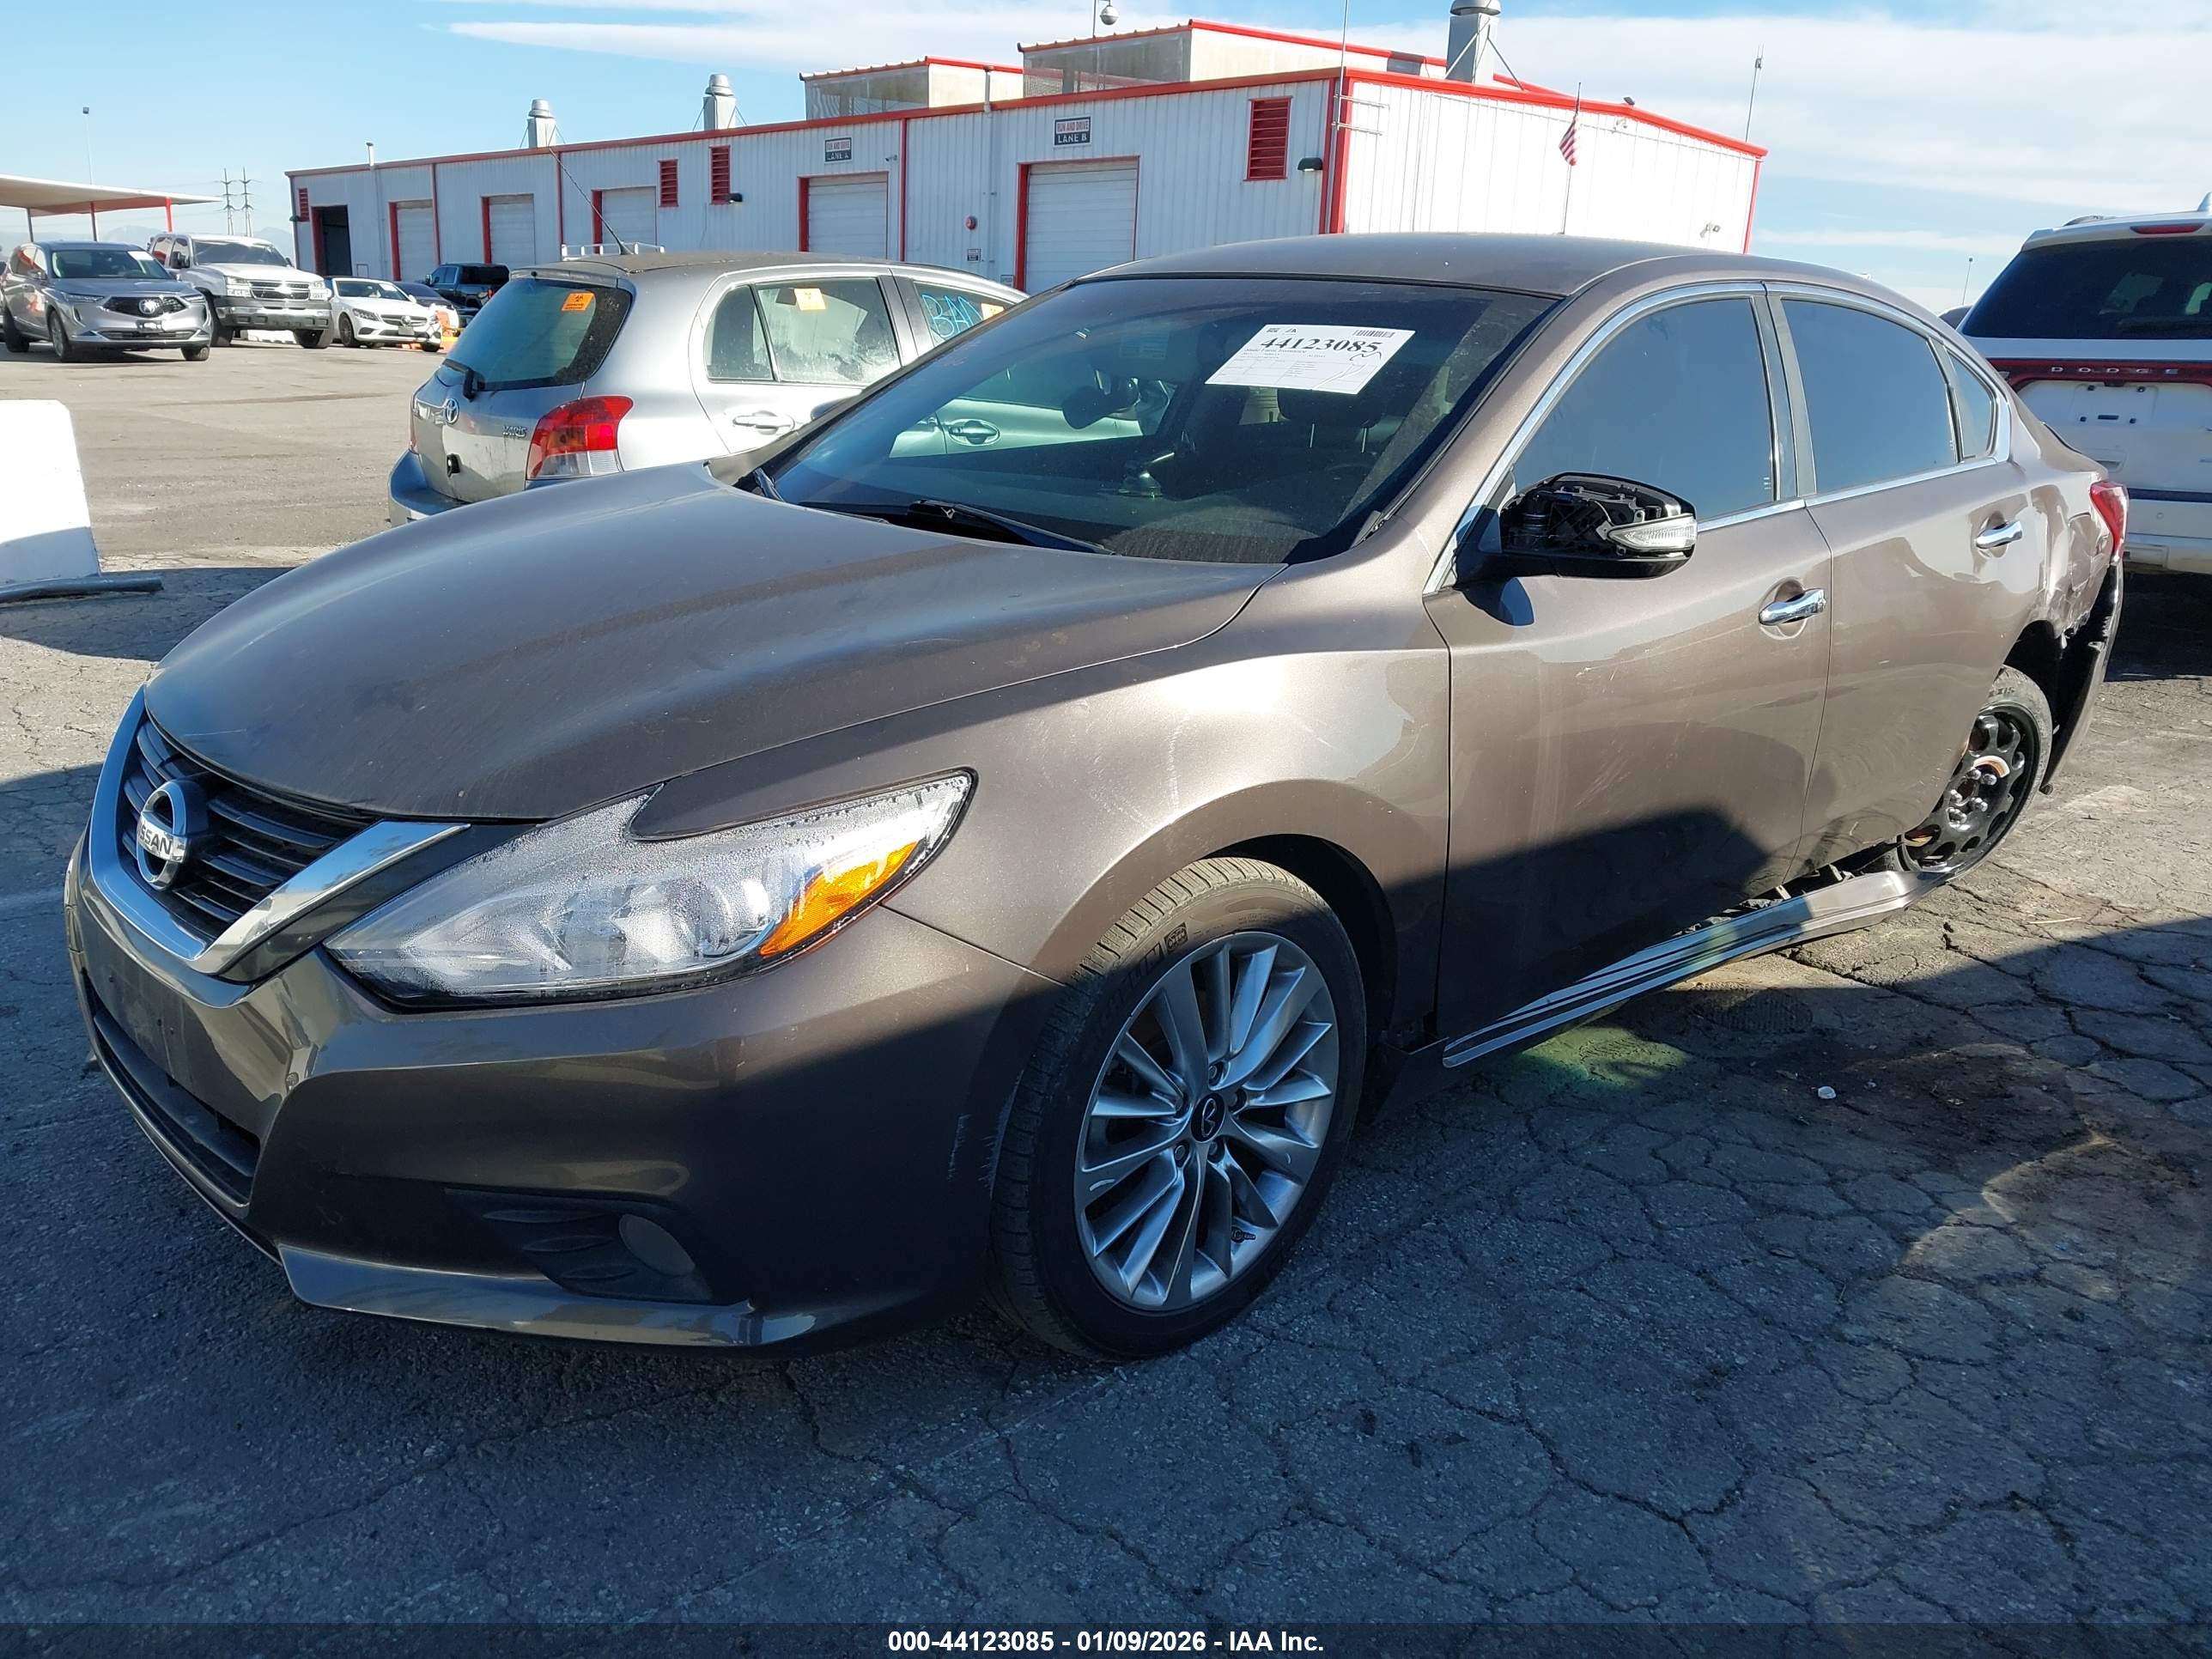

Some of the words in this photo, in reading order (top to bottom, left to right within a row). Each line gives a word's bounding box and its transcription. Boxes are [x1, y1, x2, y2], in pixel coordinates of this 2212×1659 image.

[1058, 133, 1079, 143] LANE
[1082, 133, 1087, 142] B
[827, 152, 842, 161] LANE
[1261, 337, 1382, 353] 44123085
[2051, 366, 2179, 375] DODGE
